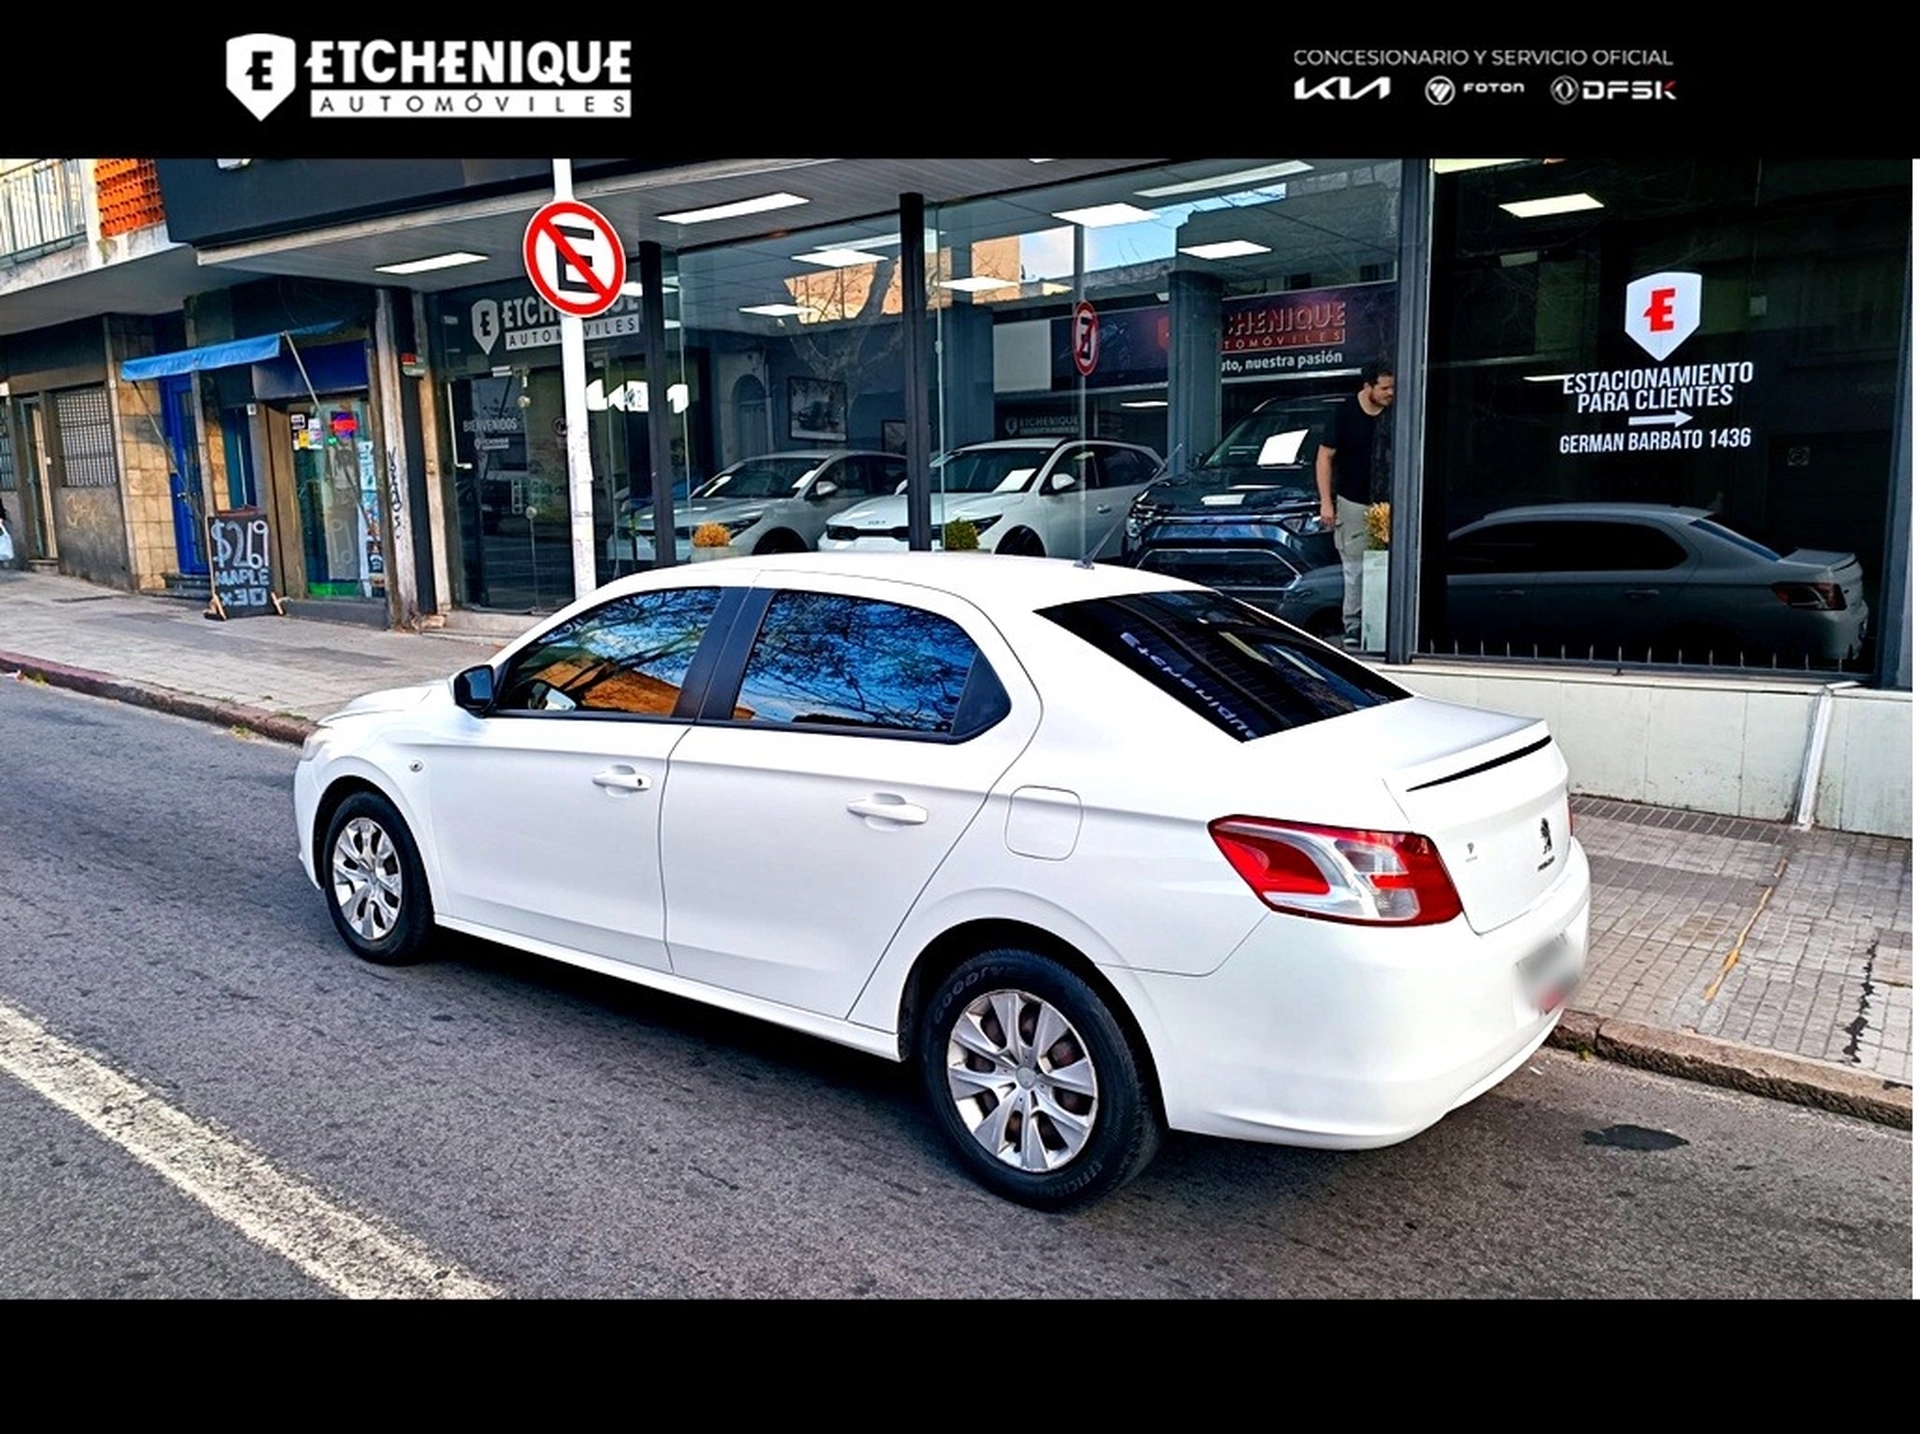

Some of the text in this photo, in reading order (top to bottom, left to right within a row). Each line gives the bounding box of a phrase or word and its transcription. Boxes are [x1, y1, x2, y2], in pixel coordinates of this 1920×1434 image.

[554, 224, 602, 293] E
[509, 317, 635, 347] AUTOVILES
[1223, 330, 1341, 349] TOMÓVILES
[1245, 355, 1295, 369] nuestra
[1297, 350, 1343, 369] pasión
[1562, 361, 1754, 395] ESTACIONAMIENTO
[1577, 384, 1734, 413] PARA CLIENTES
[1560, 427, 1752, 454] GERMAN BARBATO 1436
[210, 519, 269, 569] $269
[214, 568, 270, 586] MAPLE
